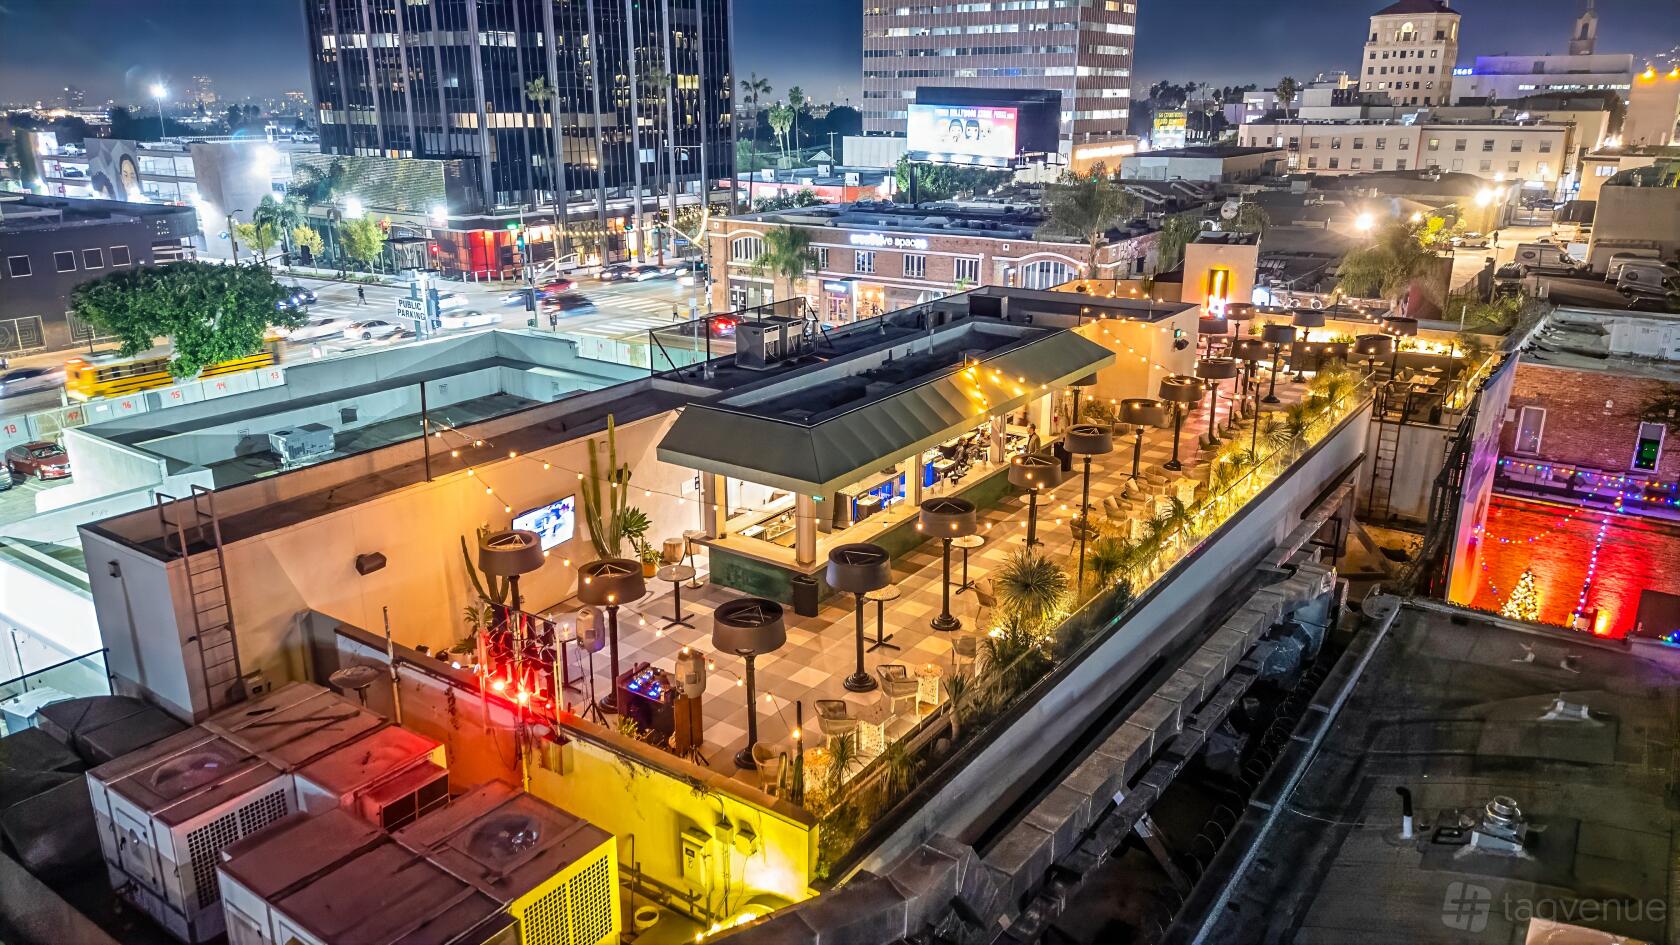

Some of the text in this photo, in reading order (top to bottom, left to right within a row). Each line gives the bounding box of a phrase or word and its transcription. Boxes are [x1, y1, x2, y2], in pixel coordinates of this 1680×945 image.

[398, 299, 421, 310] PUBLIC
[397, 308, 426, 320] PARKING
[171, 391, 181, 399] 15
[4, 424, 17, 434] 18
